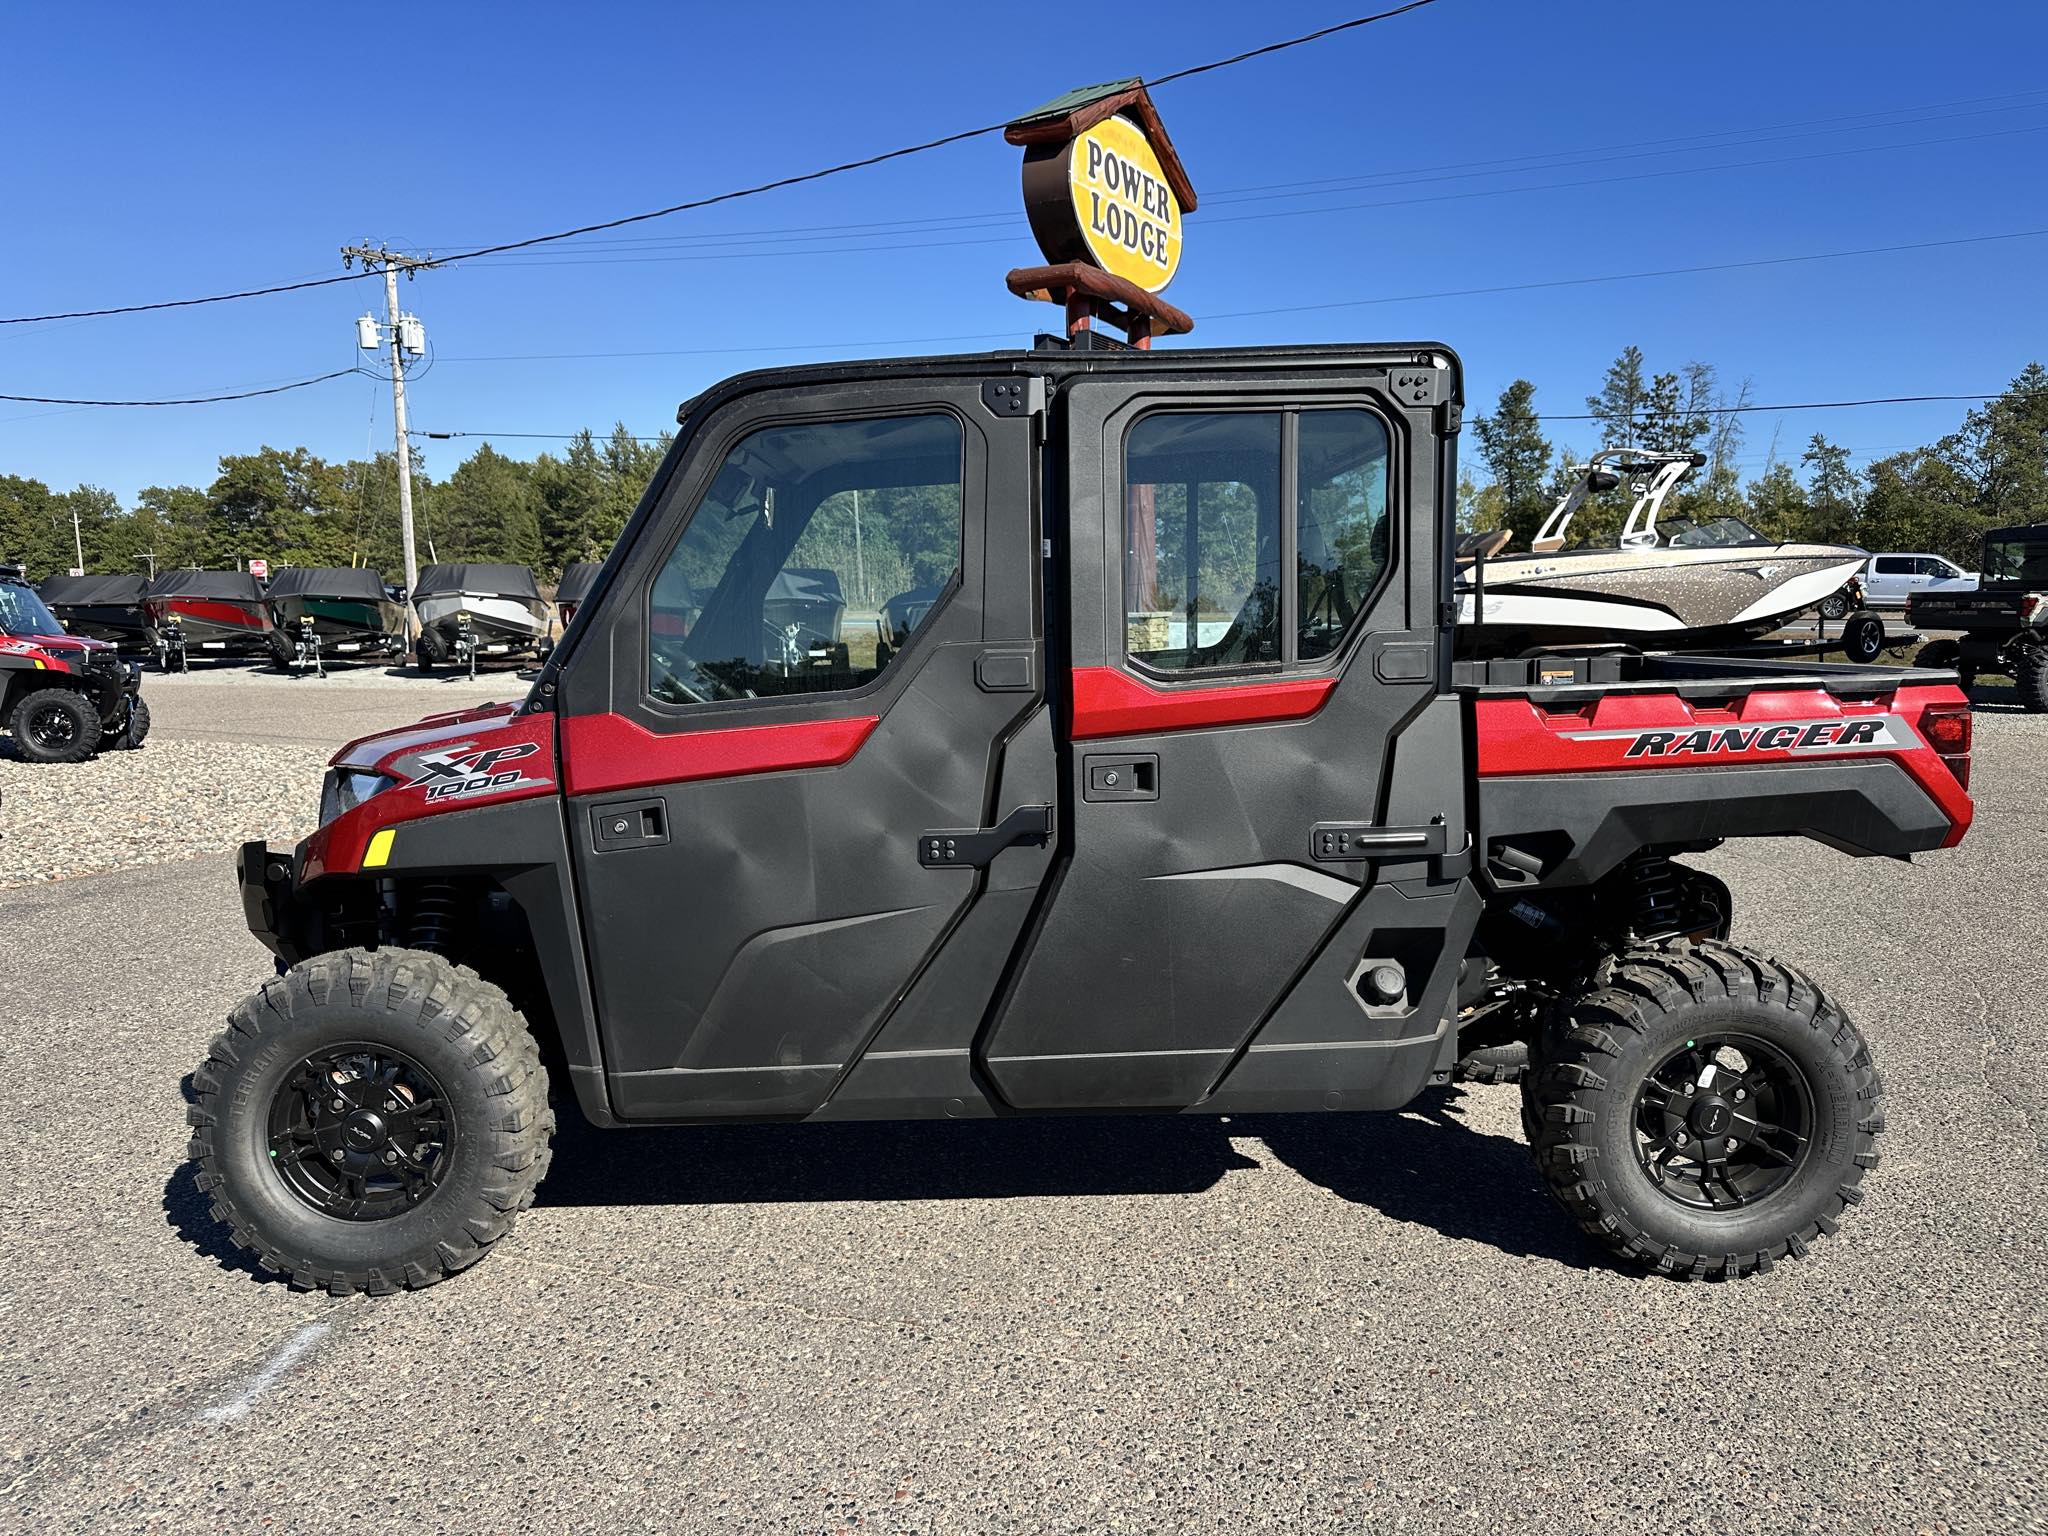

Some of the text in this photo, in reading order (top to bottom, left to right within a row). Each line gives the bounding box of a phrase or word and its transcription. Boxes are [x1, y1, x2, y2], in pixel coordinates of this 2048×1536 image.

[1087, 139, 1170, 224] POWER
[1091, 191, 1168, 266] LODGE
[1624, 719, 1886, 758] RANGER
[399, 742, 541, 790] XP
[425, 770, 522, 801] 1000
